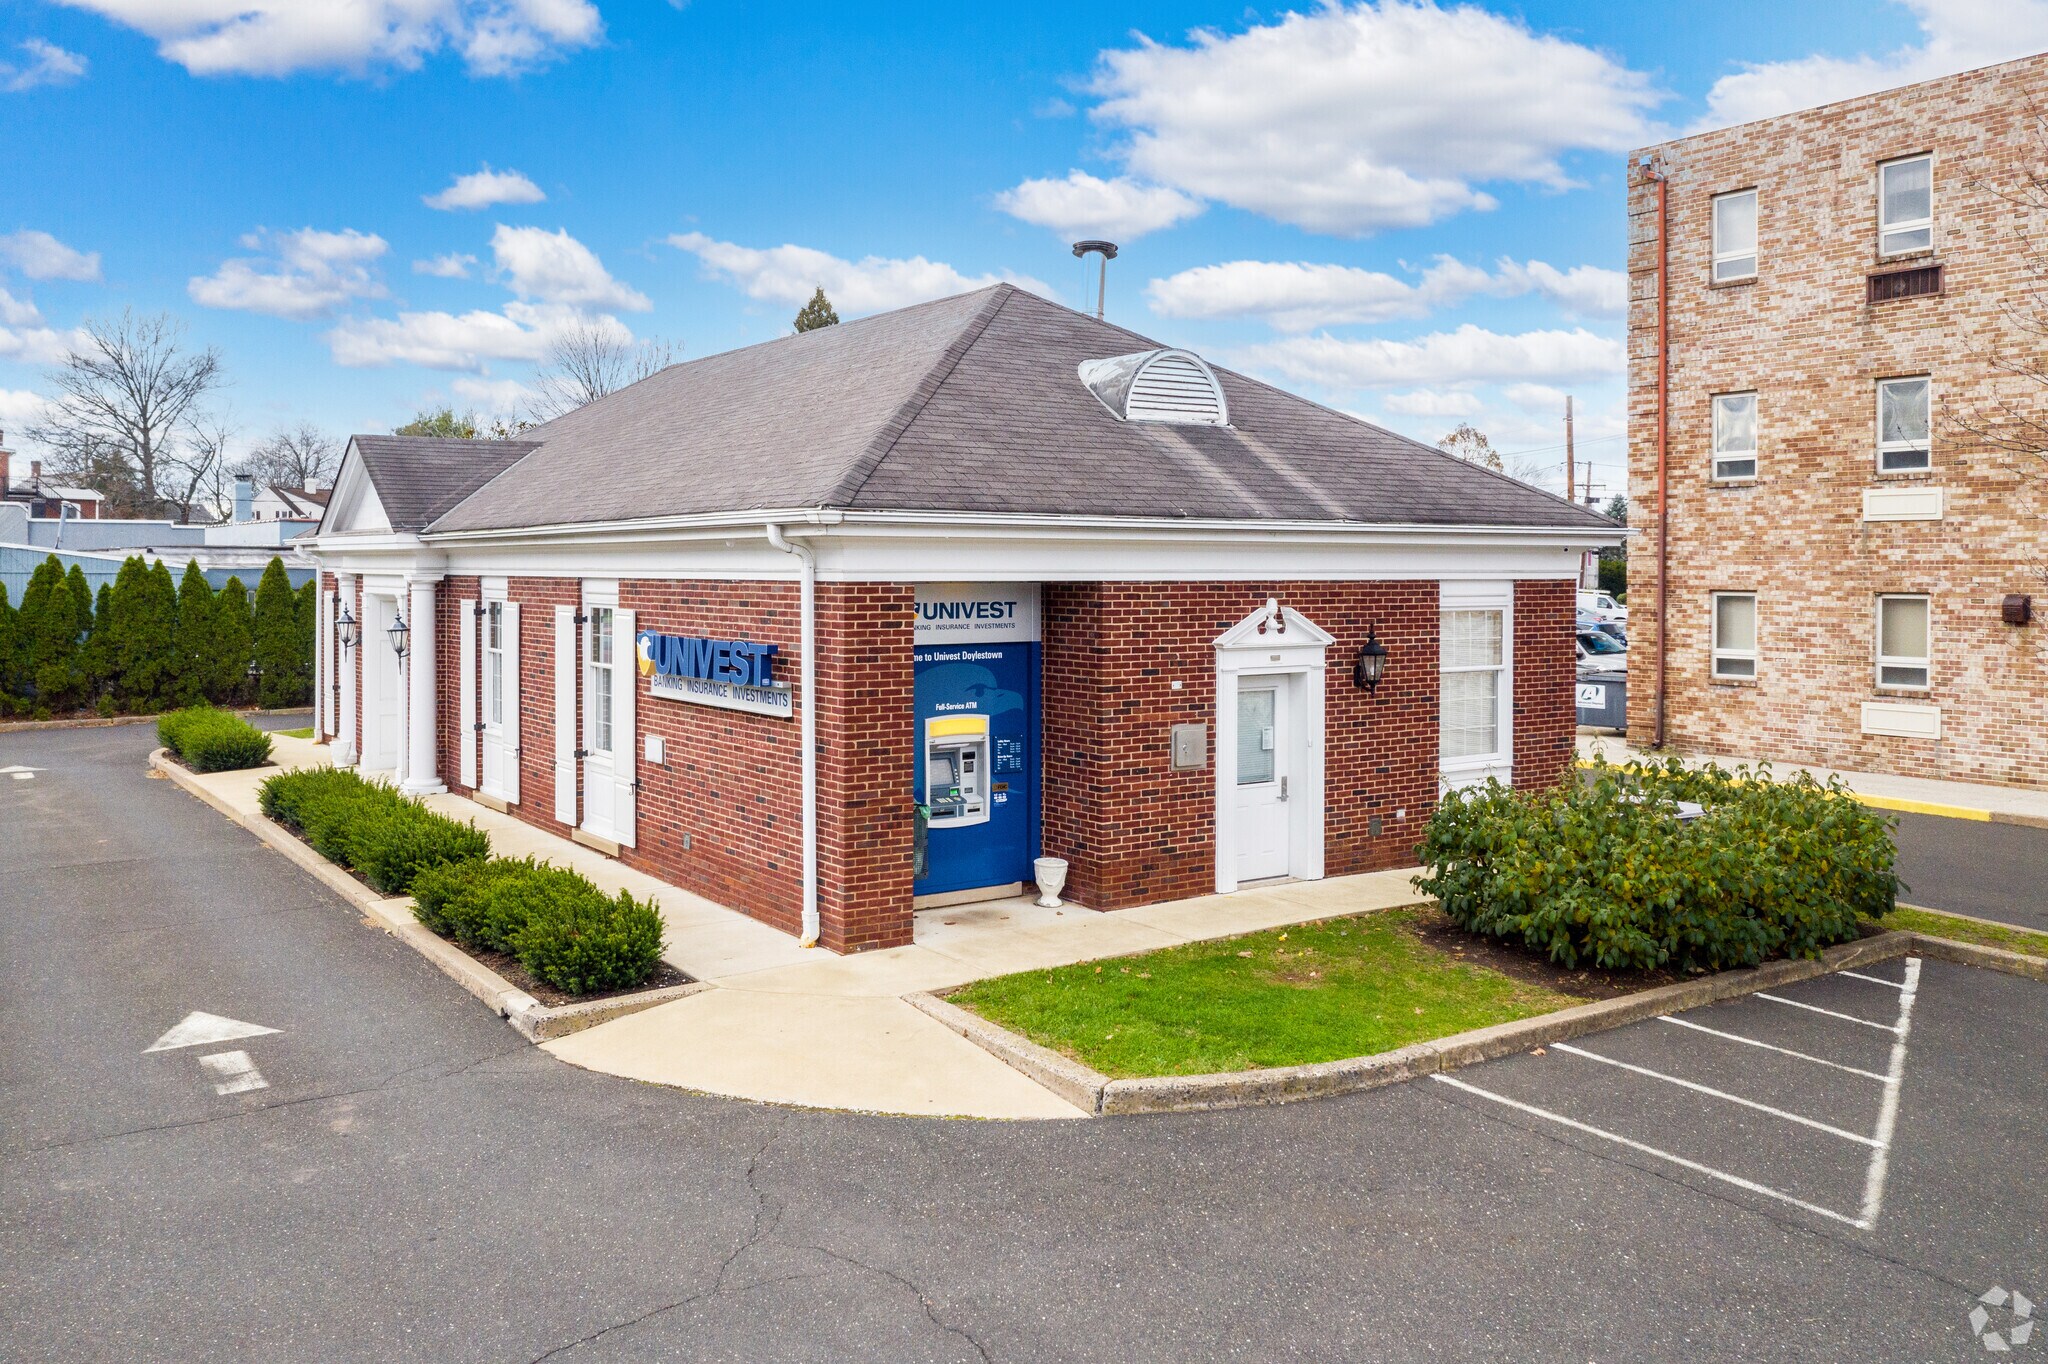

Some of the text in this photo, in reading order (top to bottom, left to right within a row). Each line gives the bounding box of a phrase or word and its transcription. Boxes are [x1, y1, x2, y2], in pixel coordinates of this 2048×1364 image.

[923, 602, 1017, 620] UNIVEST
[935, 623, 971, 631] INSURANCE
[974, 622, 1016, 630] INVESTMENTS
[655, 635, 770, 687] UNIVEST
[924, 653, 932, 662] to
[934, 651, 961, 661] Univest
[962, 650, 1003, 661] Doylestown
[653, 675, 788, 707] BANKING INSURANCE INVESTMENTS
[935, 701, 977, 710] Full-Service ATM
